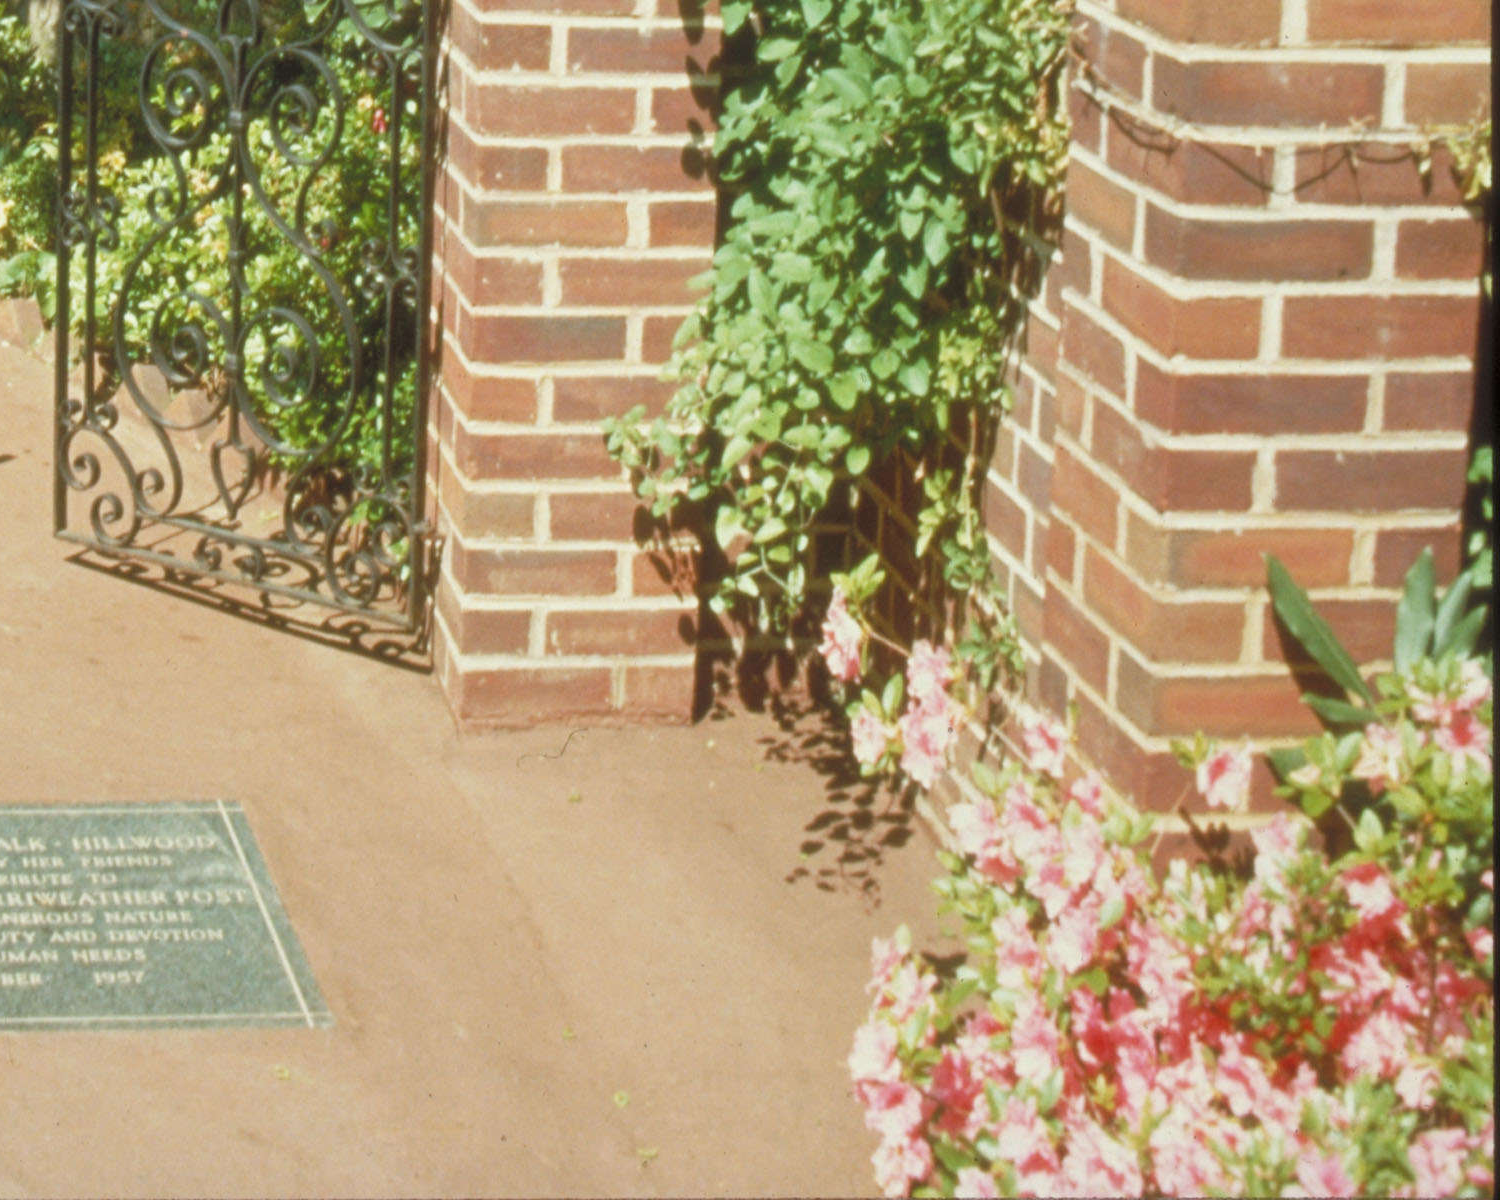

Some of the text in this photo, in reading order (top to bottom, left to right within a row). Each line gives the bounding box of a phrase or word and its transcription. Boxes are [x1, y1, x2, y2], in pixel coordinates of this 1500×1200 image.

[71, 835, 217, 851] HILLWOOD
[22, 856, 65, 868] HER
[81, 855, 173, 867] FRIENDS
[88, 872, 118, 885] TO
[173, 888, 248, 905] POST
[103, 910, 194, 923] NATURE
[49, 930, 98, 943] AND
[107, 928, 224, 942] DEVOTION
[71, 948, 147, 963] NEEDS
[92, 970, 146, 986] 1957
